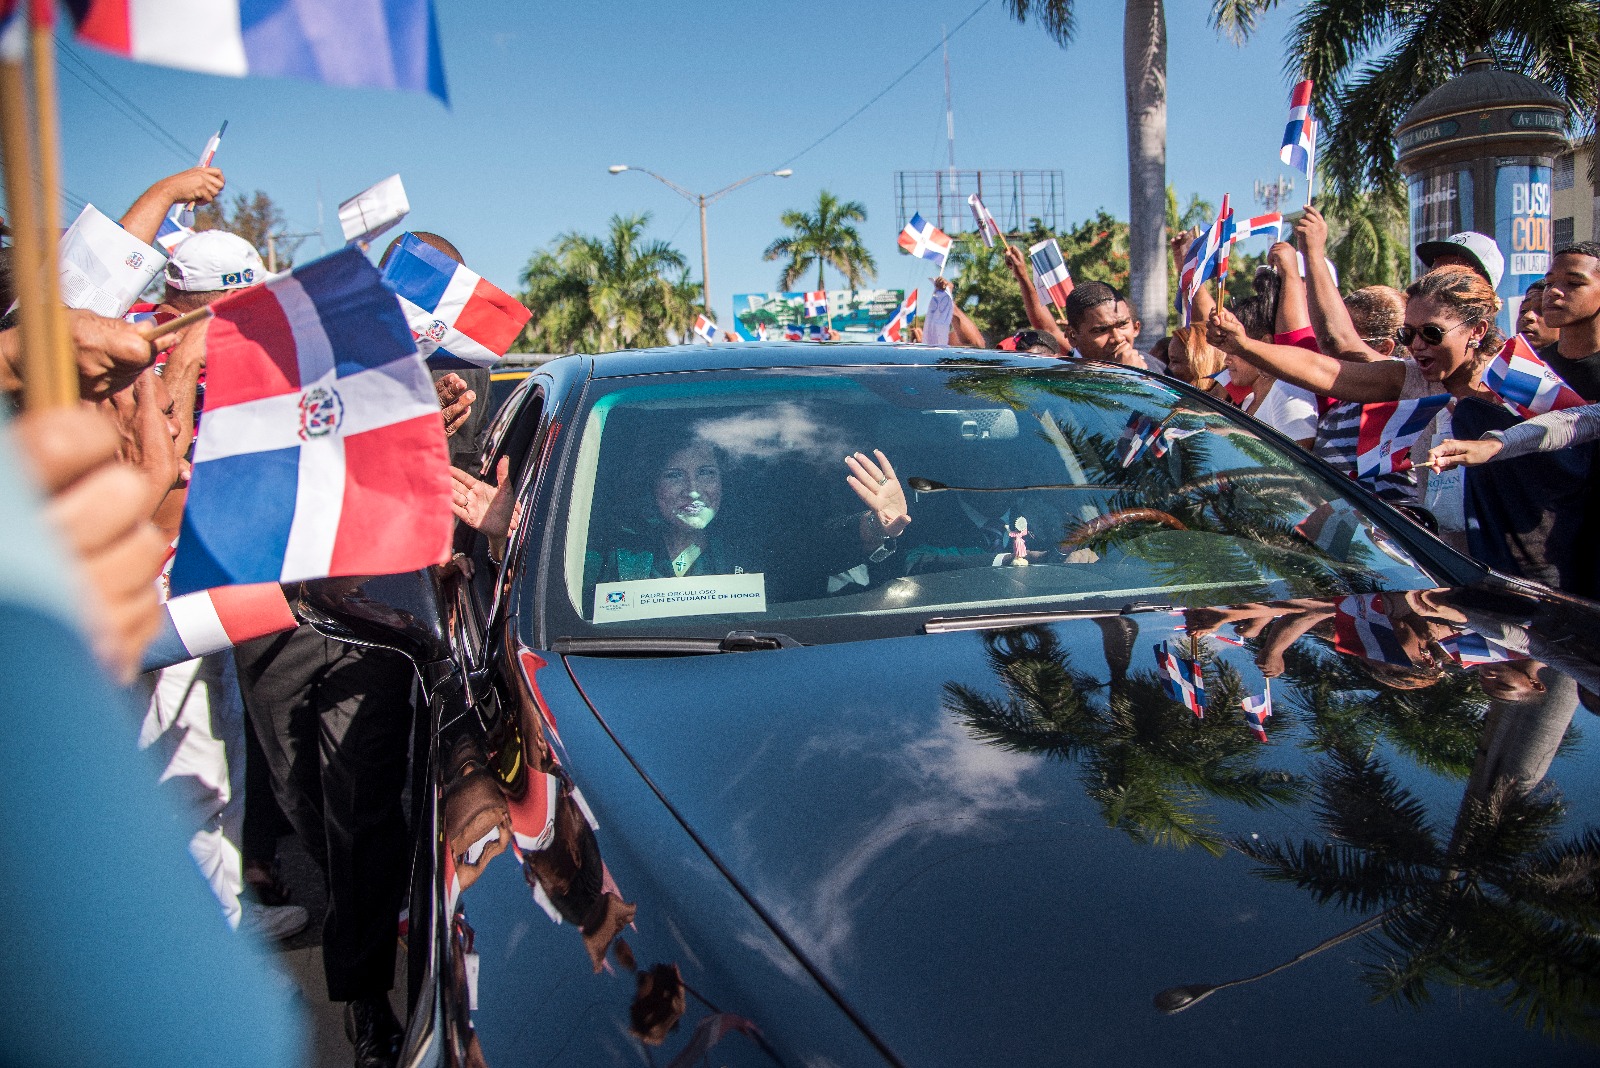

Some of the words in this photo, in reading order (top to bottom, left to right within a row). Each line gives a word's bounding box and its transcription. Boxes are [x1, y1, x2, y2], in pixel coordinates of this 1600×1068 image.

[1415, 125, 1441, 142] MOYA
[1515, 255, 1526, 272] EN
[1528, 255, 1540, 272] LAS
[666, 594, 717, 603] ESTUDIANTE
[667, 589, 717, 597] ORGULLOSO
